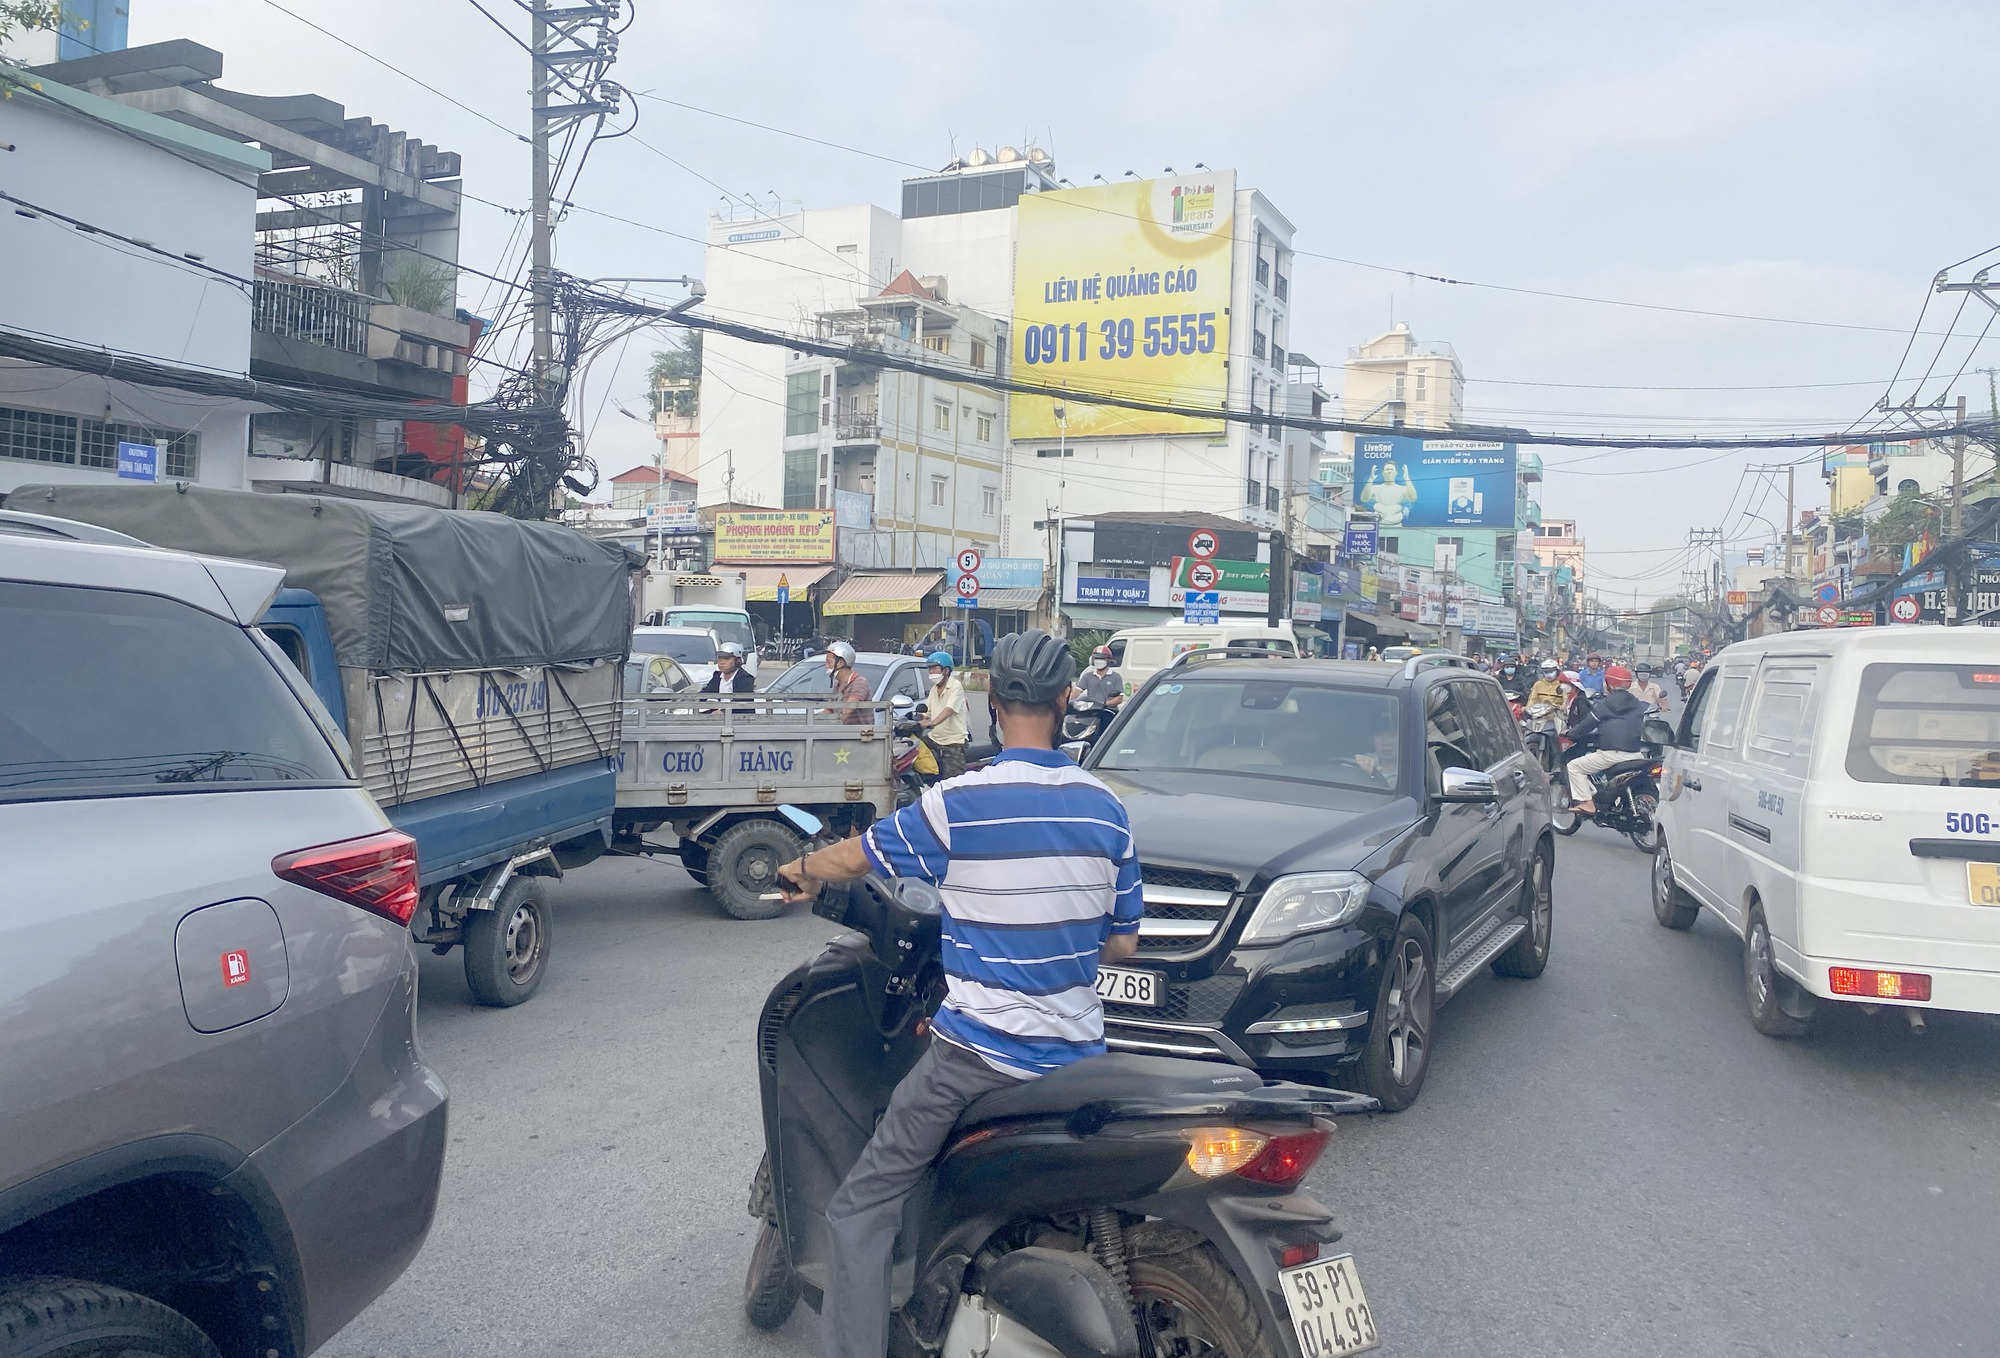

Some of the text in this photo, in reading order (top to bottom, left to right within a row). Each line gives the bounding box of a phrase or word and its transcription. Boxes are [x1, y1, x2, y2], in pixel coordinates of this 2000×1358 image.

[1184, 209, 1214, 222] years
[1171, 222, 1213, 232] ANNIVERSARY
[1045, 265, 1197, 304] LIÊN HỆ QUẢNG CÁO
[1025, 312, 1216, 365] 0911 39 5555
[1364, 443, 1393, 452] LiveSpo
[1463, 458, 1477, 466] ĐẠI
[1478, 456, 1505, 464] TRÀNG
[726, 524, 761, 538] PHƯỢNG
[764, 523, 795, 537] HOÀNG
[1080, 586, 1146, 599] TRẠM THÚ Y QUẬN 7
[663, 743, 705, 773] CHỞ
[739, 745, 793, 772] HÀNG
[1825, 809, 1883, 821] THACO
[1946, 812, 2000, 834] 50G-
[1211, 1077, 1243, 1085] HONDA
[1300, 1302, 1376, 1358] 044.93
